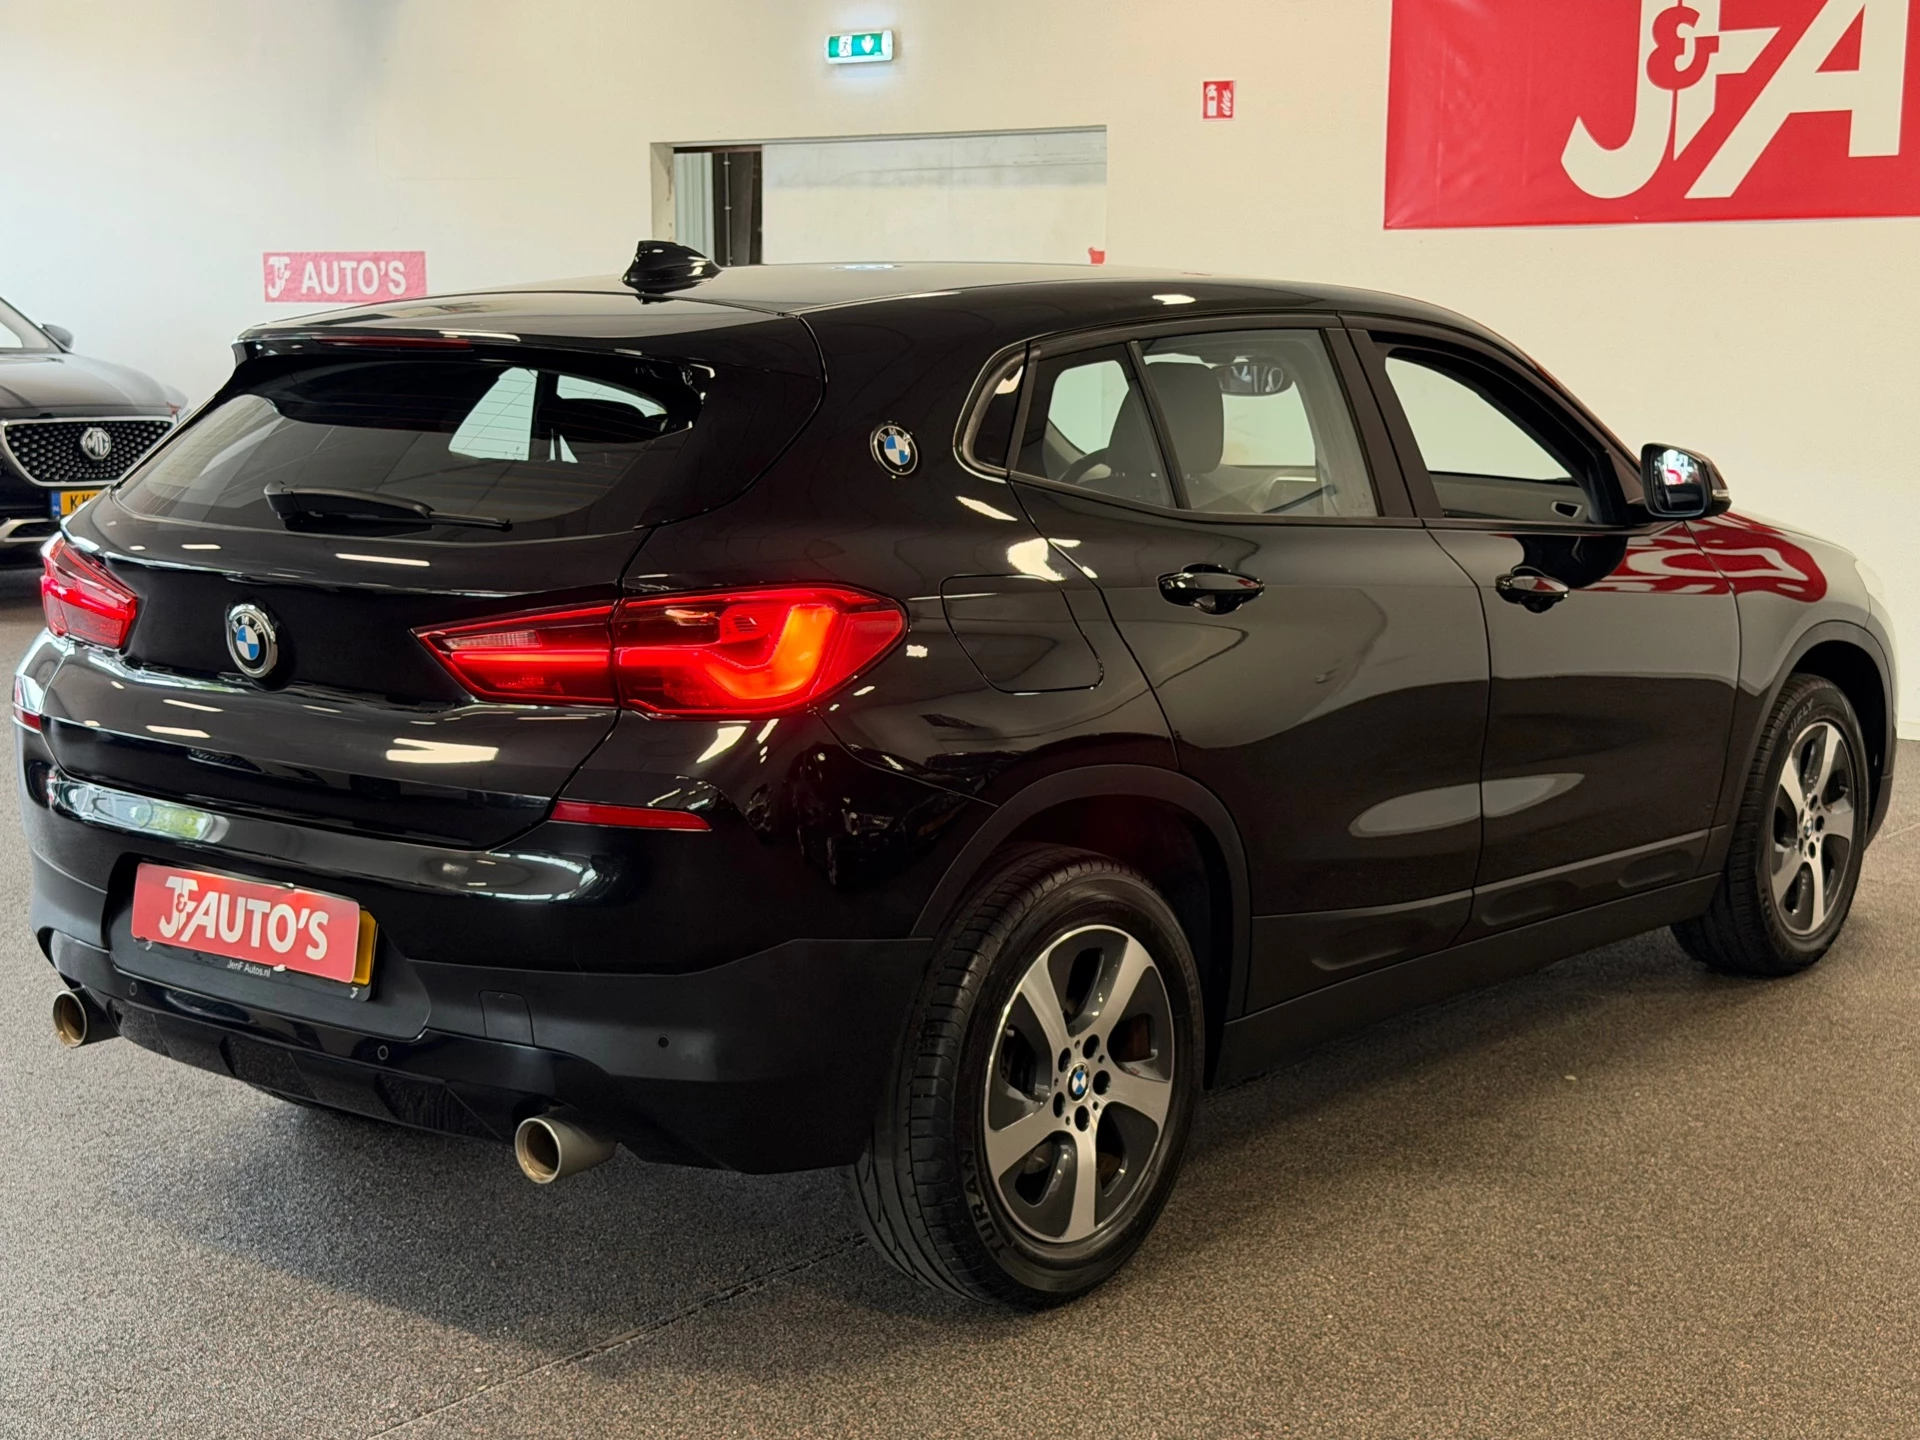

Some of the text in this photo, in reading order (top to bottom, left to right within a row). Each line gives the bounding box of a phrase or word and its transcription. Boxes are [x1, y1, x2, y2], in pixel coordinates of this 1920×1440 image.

[301, 260, 407, 295] AUTO'S
[86, 431, 110, 456] MG
[232, 615, 264, 635] BMW
[180, 891, 330, 961] AUTO'S
[227, 959, 271, 977] JenF Autos.nl
[957, 1124, 1006, 1259] TURAN
